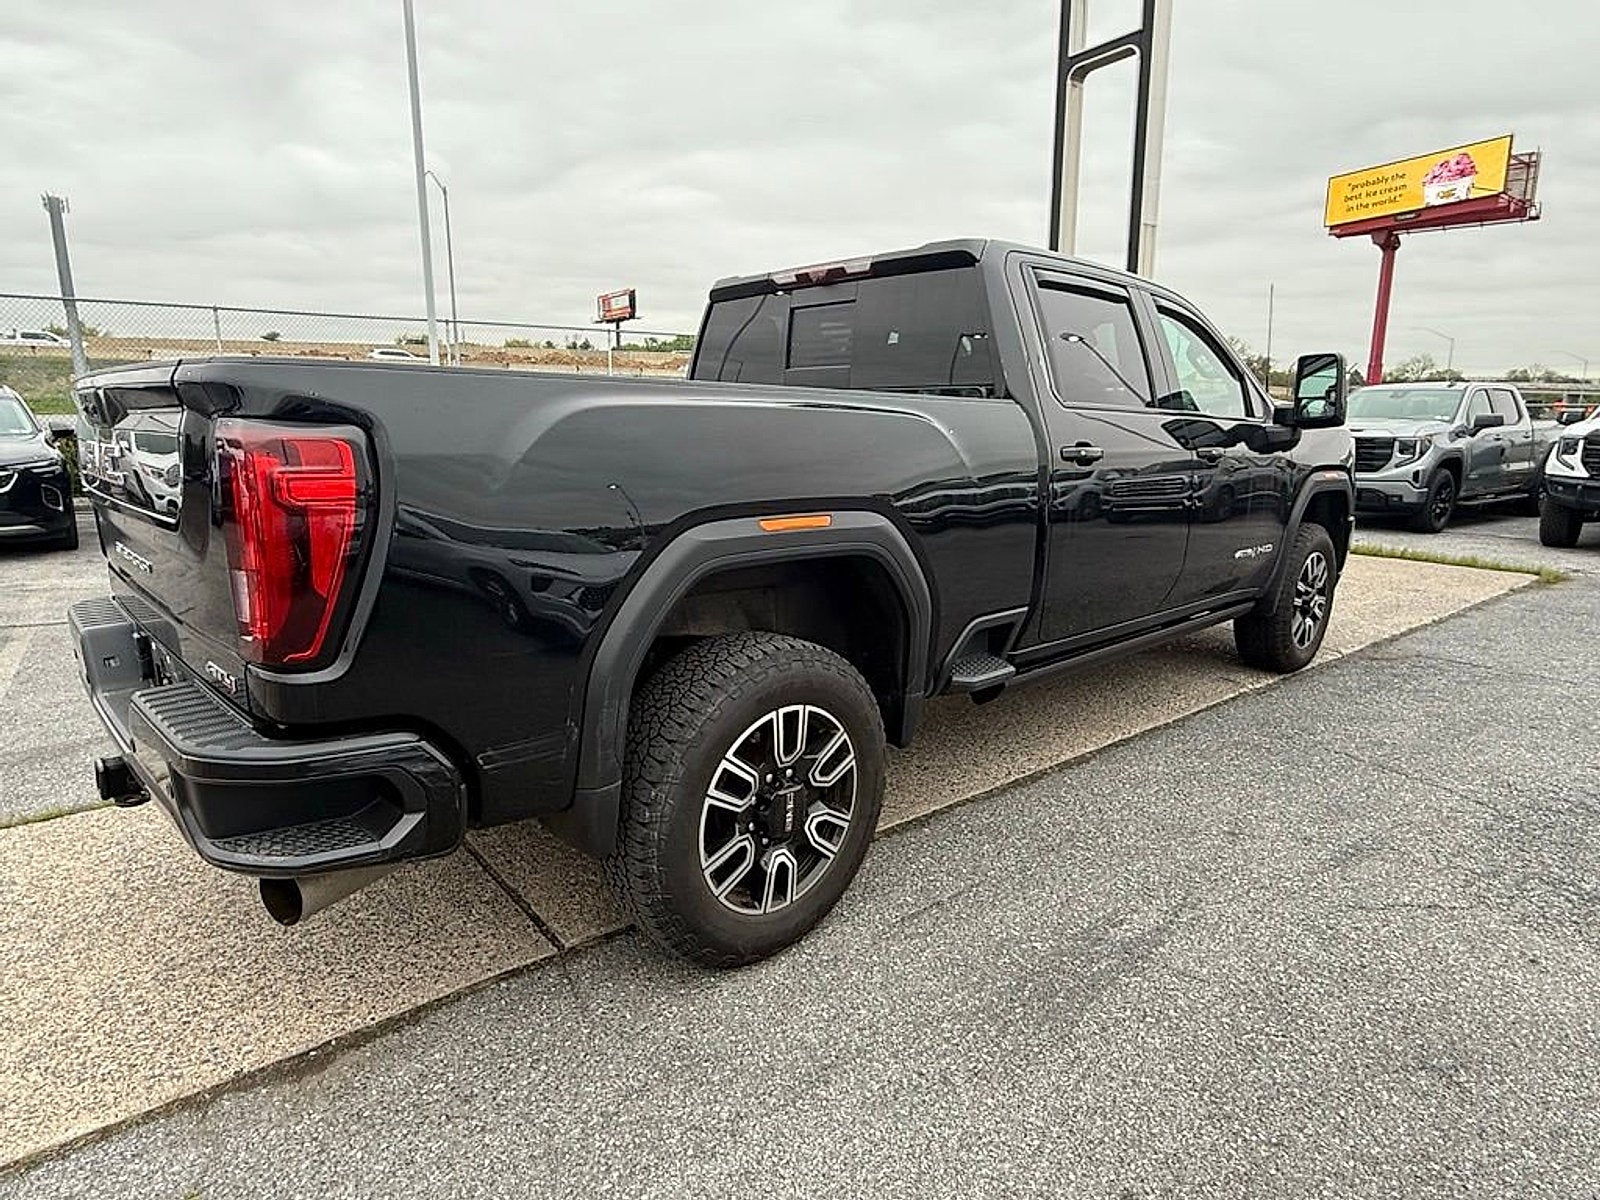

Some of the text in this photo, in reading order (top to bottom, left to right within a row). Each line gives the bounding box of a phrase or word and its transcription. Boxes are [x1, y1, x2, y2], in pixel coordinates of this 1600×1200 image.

[1391, 172, 1407, 181] the
[1343, 184, 1407, 203] best ice cream
[1345, 204, 1354, 213] in
[1356, 203, 1370, 211] the
